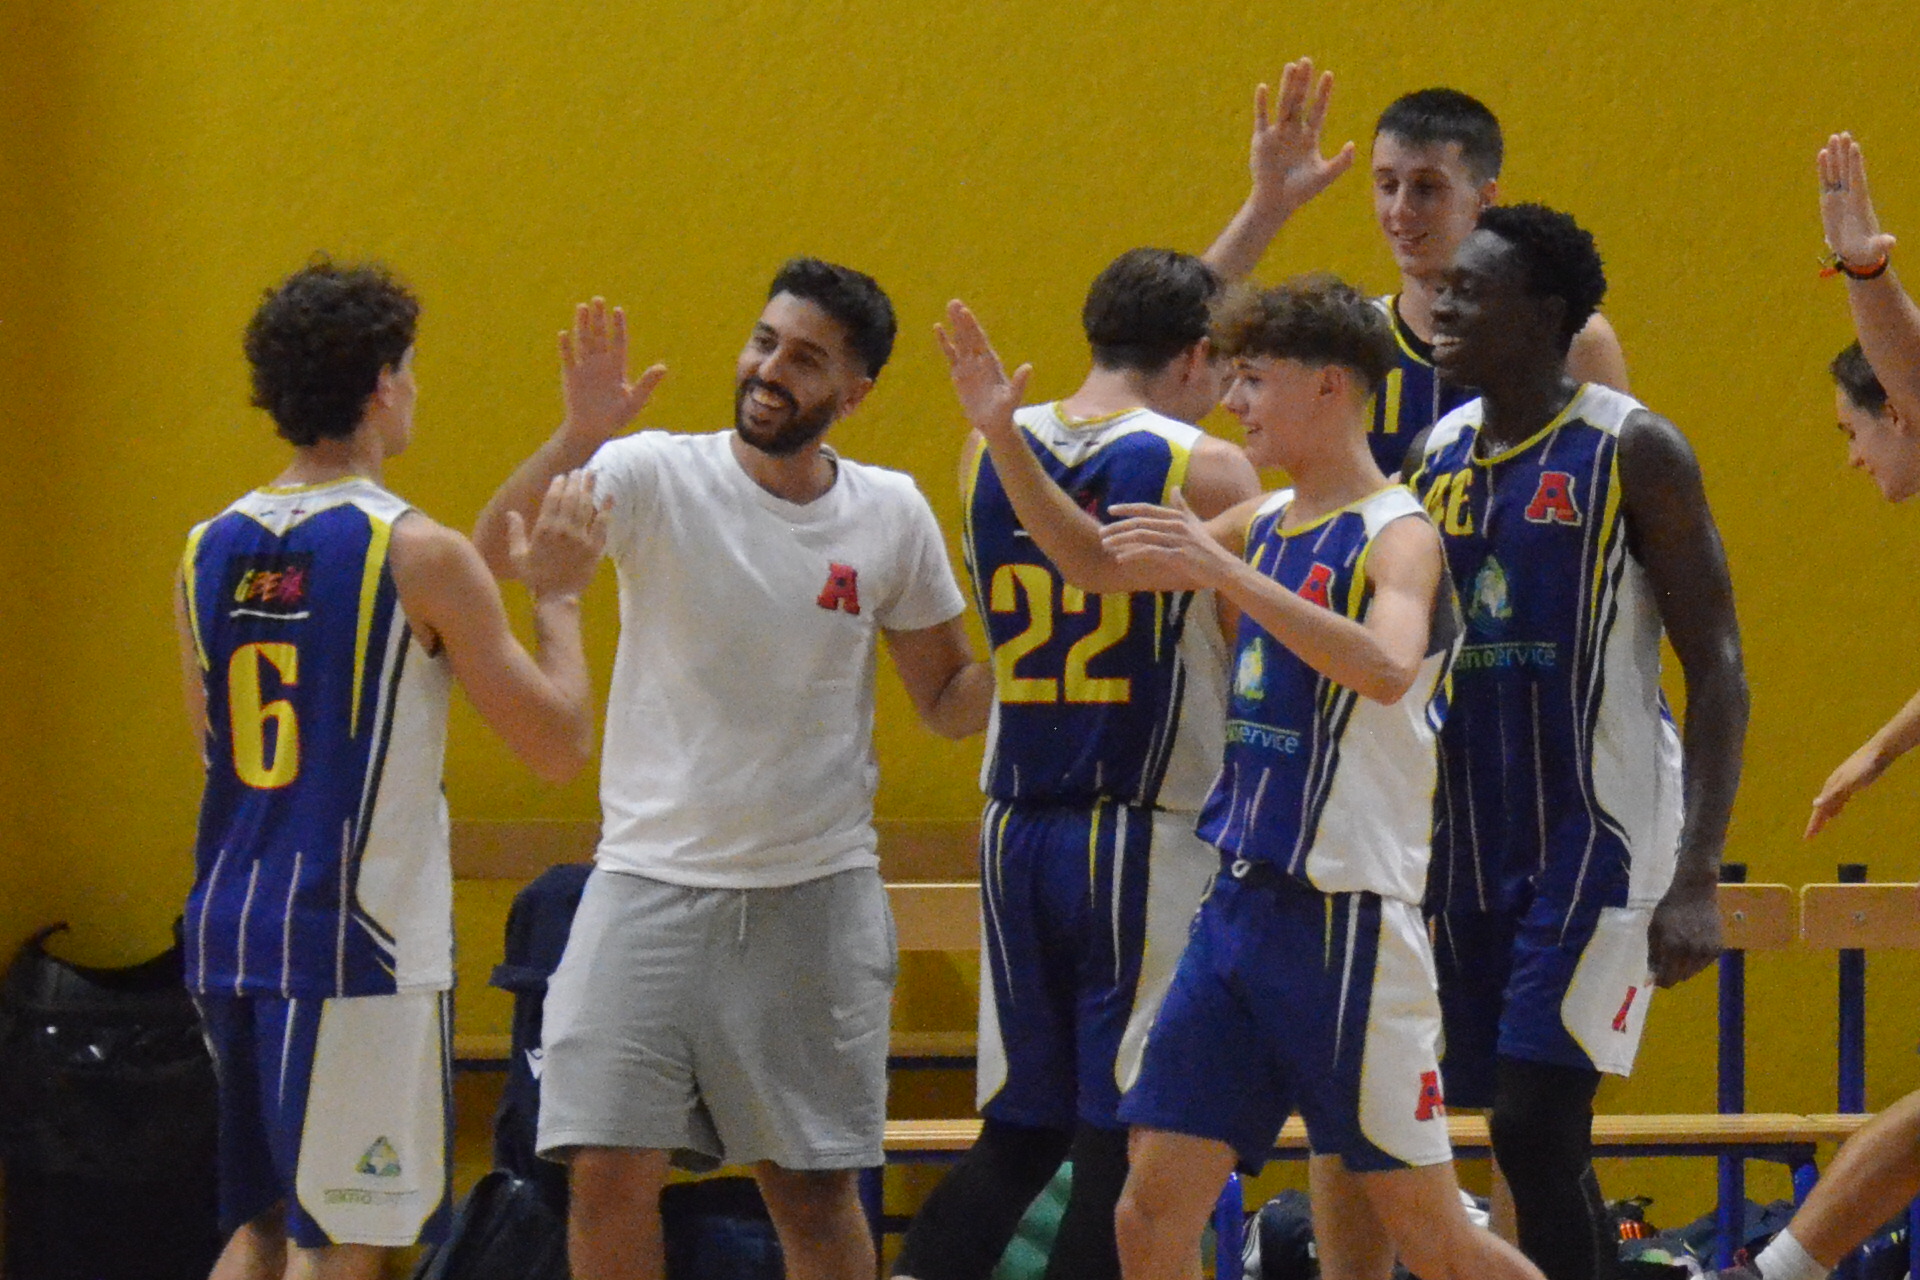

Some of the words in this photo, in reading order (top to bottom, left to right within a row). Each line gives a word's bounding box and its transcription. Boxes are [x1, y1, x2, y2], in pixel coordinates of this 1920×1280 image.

[1525, 471, 1582, 526] A
[816, 562, 861, 615] A
[990, 563, 1132, 704] 22
[228, 641, 299, 789] 6
